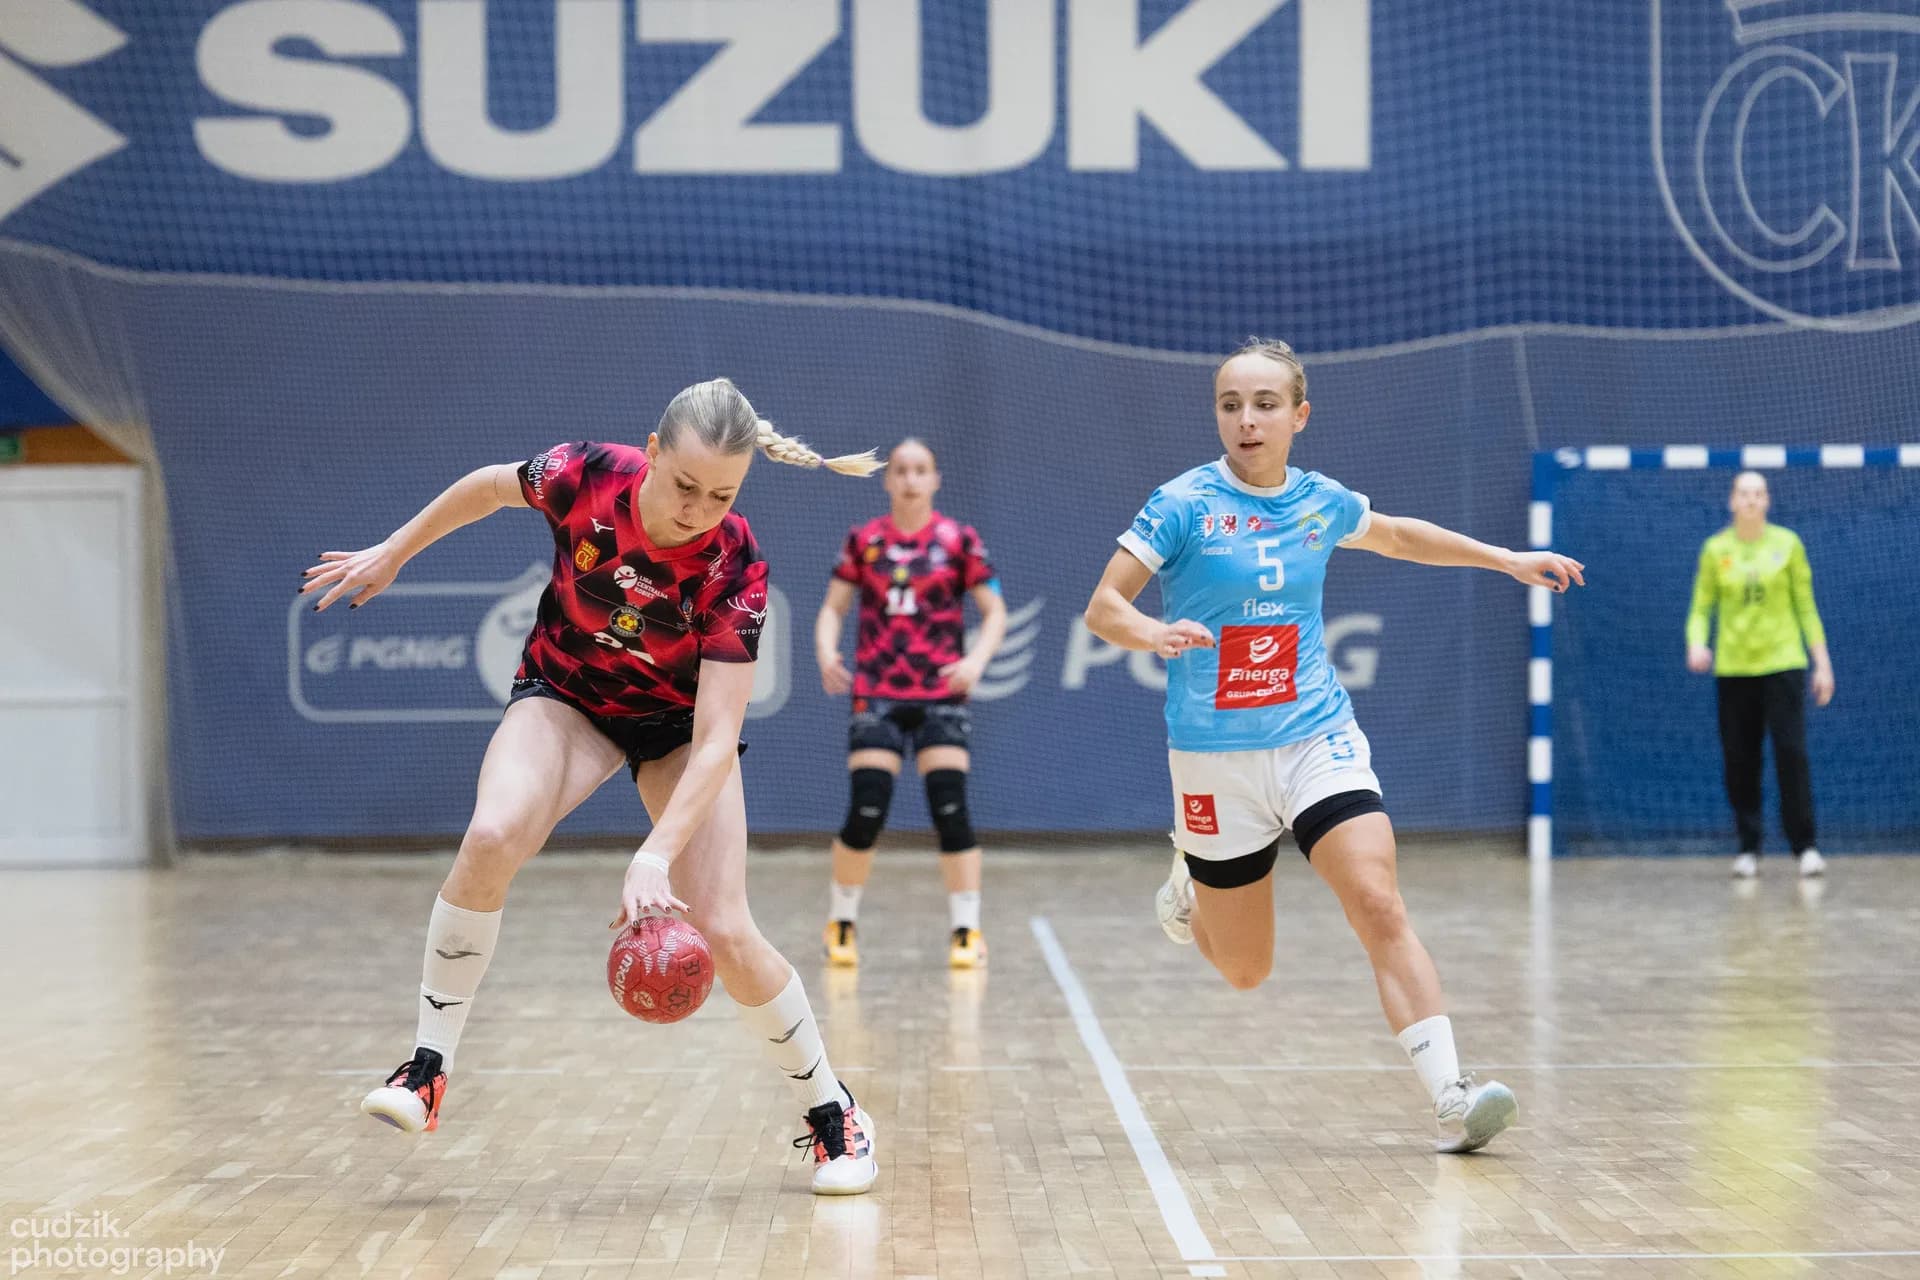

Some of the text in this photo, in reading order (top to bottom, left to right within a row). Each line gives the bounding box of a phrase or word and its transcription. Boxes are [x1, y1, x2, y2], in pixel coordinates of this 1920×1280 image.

[194, 0, 1371, 182] SUZUKI
[1257, 539, 1285, 592] 5
[1242, 598, 1285, 617] flex
[1228, 667, 1290, 686] Energa
